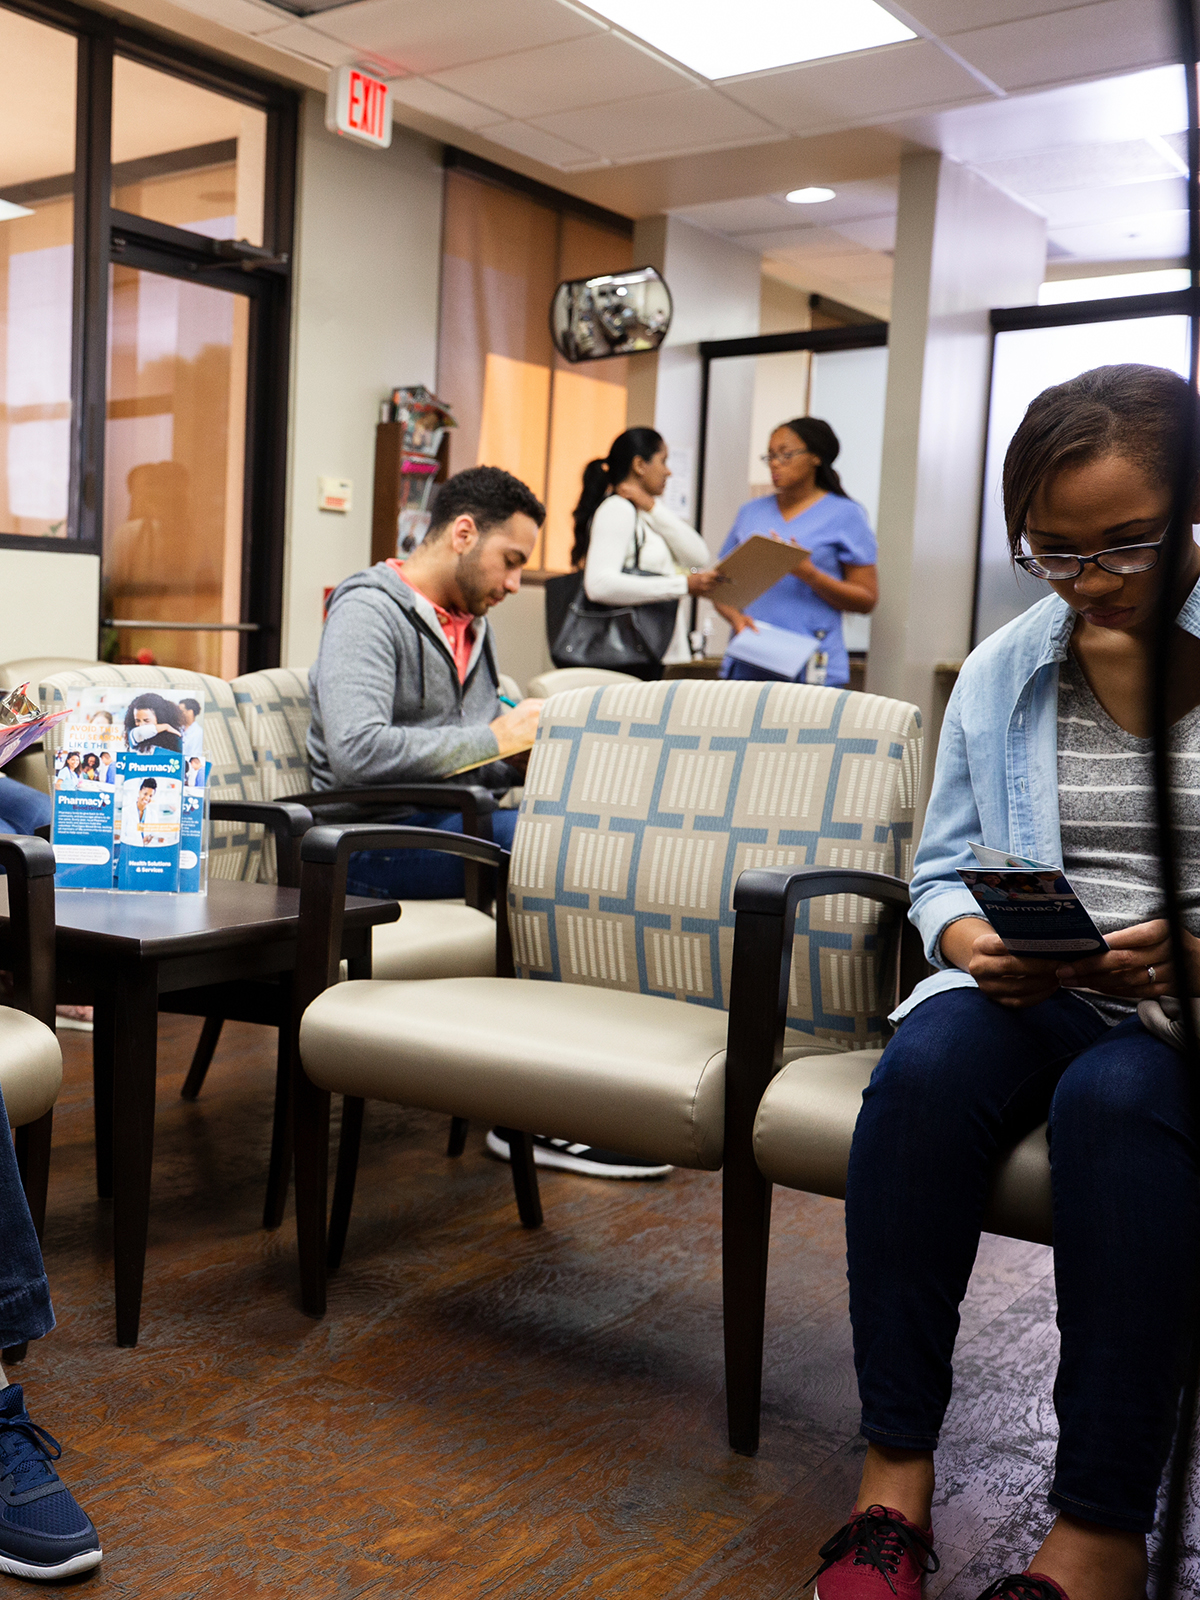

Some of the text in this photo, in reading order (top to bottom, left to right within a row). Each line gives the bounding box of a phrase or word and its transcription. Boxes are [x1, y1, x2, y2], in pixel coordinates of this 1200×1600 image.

[347, 69, 388, 140] EXIT
[129, 762, 173, 773] Pharmacy
[58, 795, 103, 807] Pharmacy
[985, 903, 1062, 912] Pharmacy
